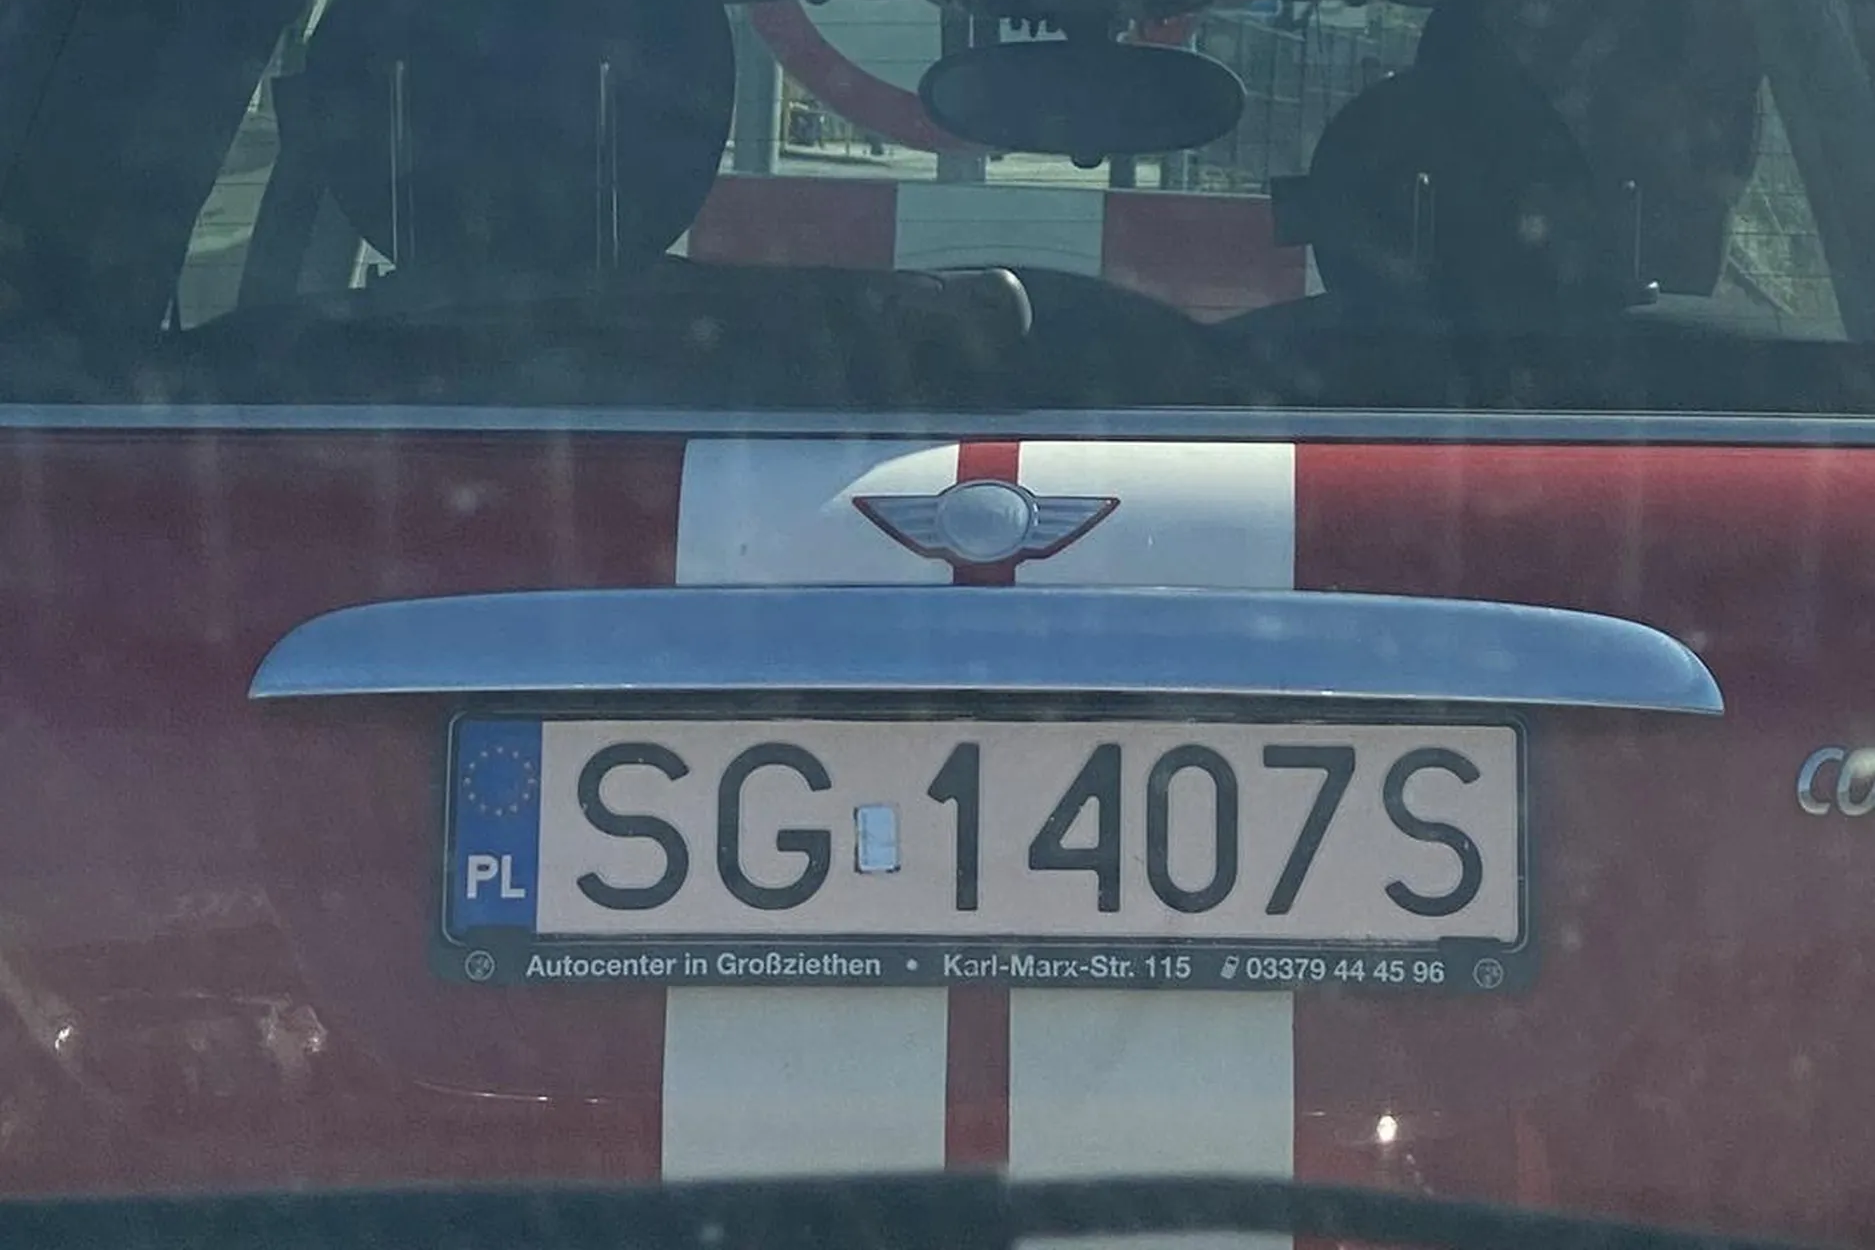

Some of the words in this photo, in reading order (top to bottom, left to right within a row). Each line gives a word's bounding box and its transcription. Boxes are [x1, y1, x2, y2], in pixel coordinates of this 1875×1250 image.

[576, 741, 833, 911] SG
[927, 741, 1484, 918] 1407S
[466, 855, 526, 900] PL
[525, 954, 678, 978] Autocenter
[684, 952, 708, 976] in
[716, 952, 882, 977] Großziethen
[943, 953, 1135, 978] Karl-Marx-Str.
[1145, 956, 1192, 979] 115
[1245, 957, 1327, 981] 03379
[1333, 959, 1366, 982] 44
[1372, 960, 1406, 983] 45
[1412, 961, 1446, 984] 96
